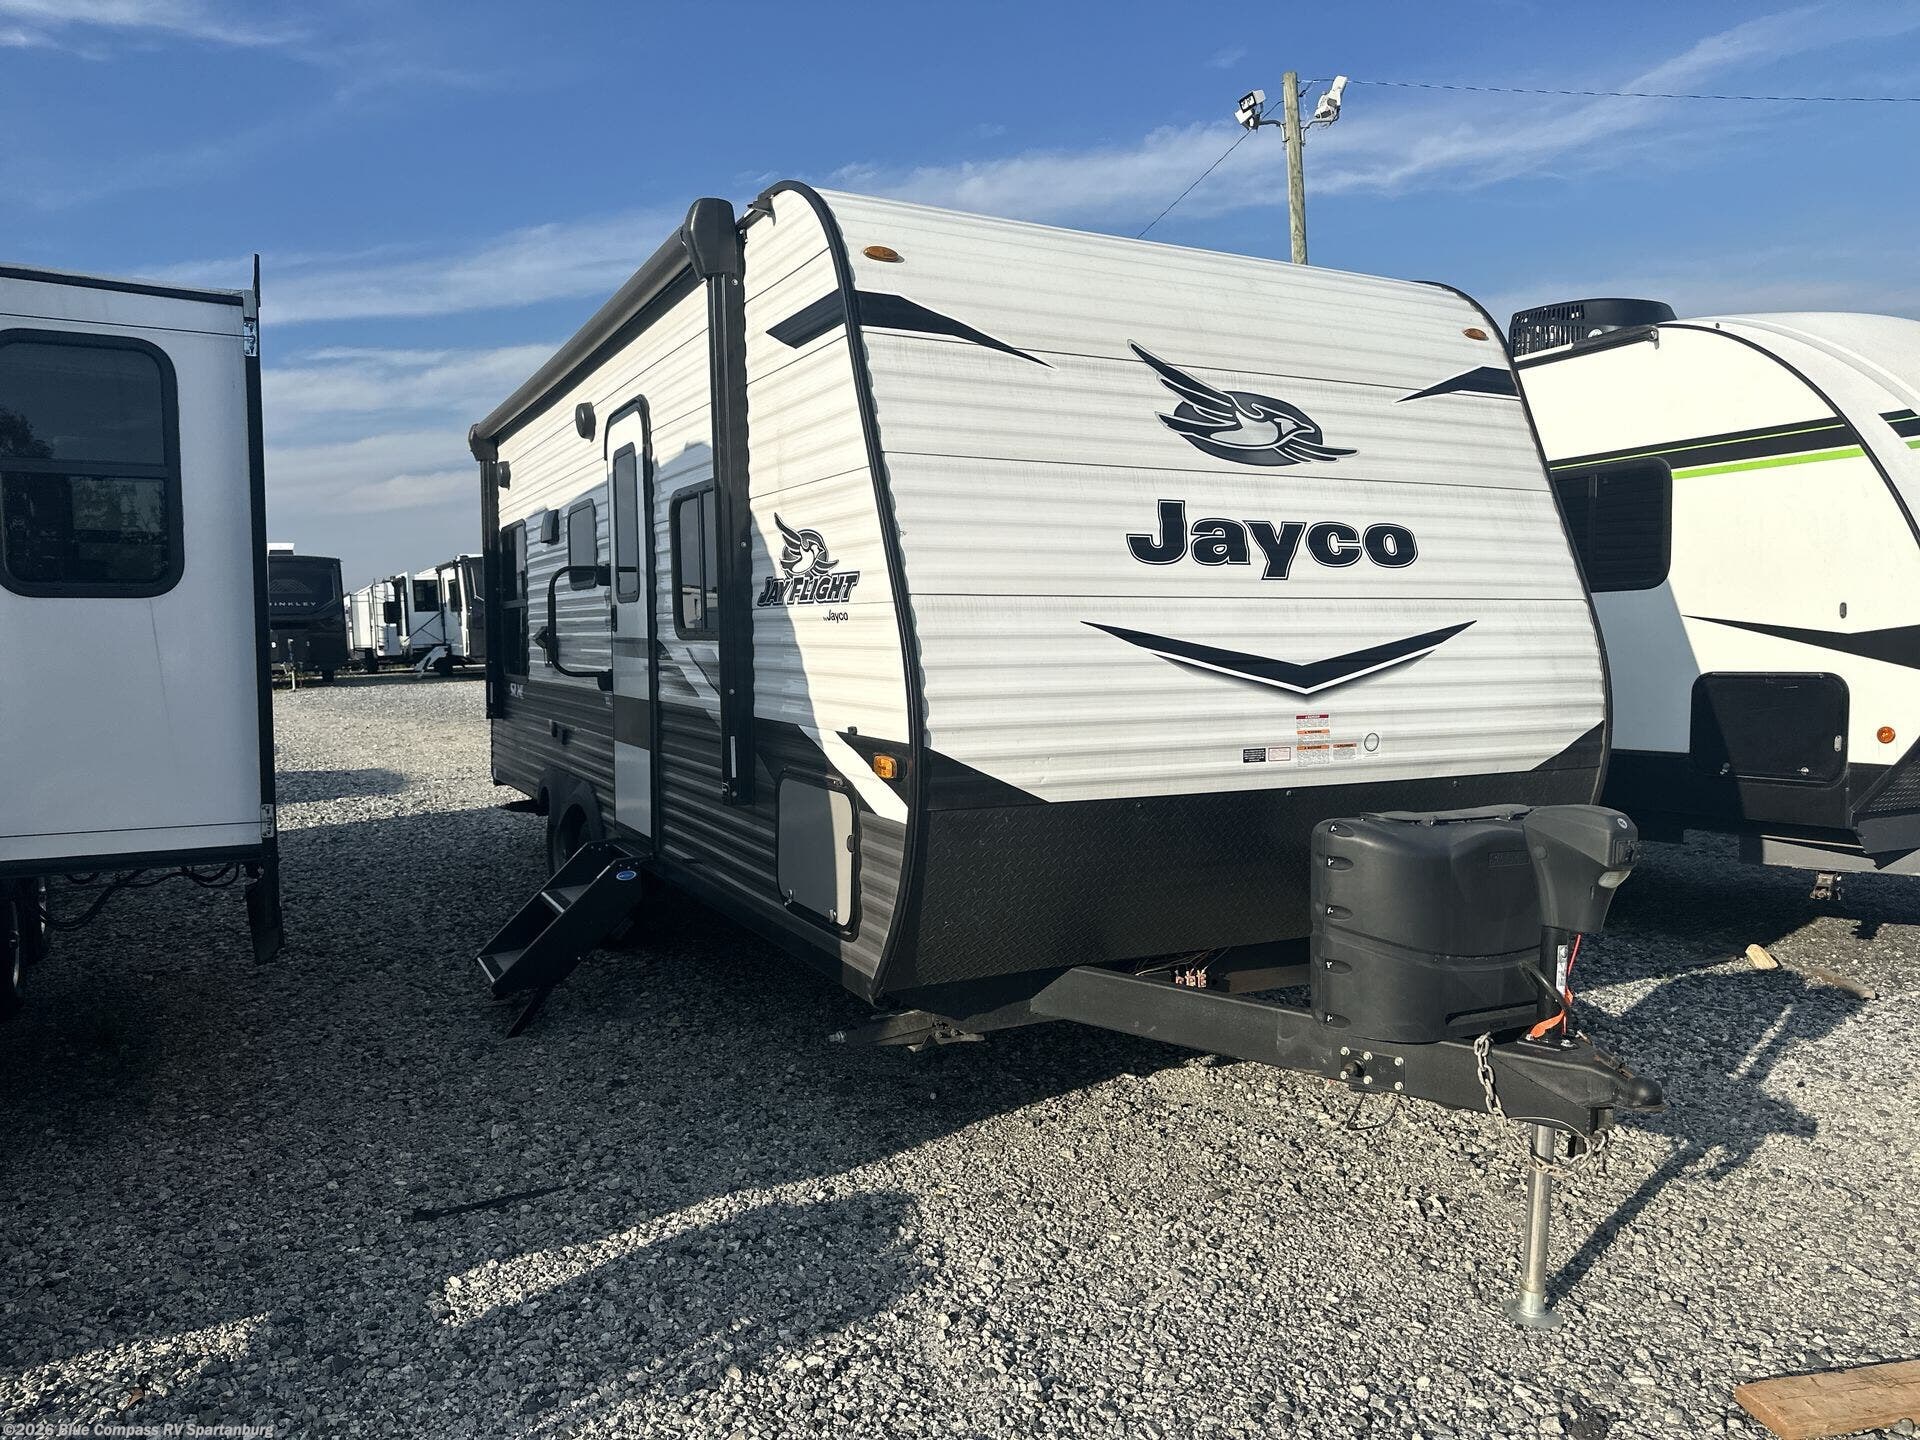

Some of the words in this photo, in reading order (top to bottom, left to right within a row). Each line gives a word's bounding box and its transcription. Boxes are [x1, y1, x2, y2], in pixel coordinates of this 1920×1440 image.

[1126, 499, 1418, 580] Jayco
[757, 576, 791, 606] JAY
[786, 571, 860, 605] FLIGHT
[826, 609, 849, 624] Jayco
